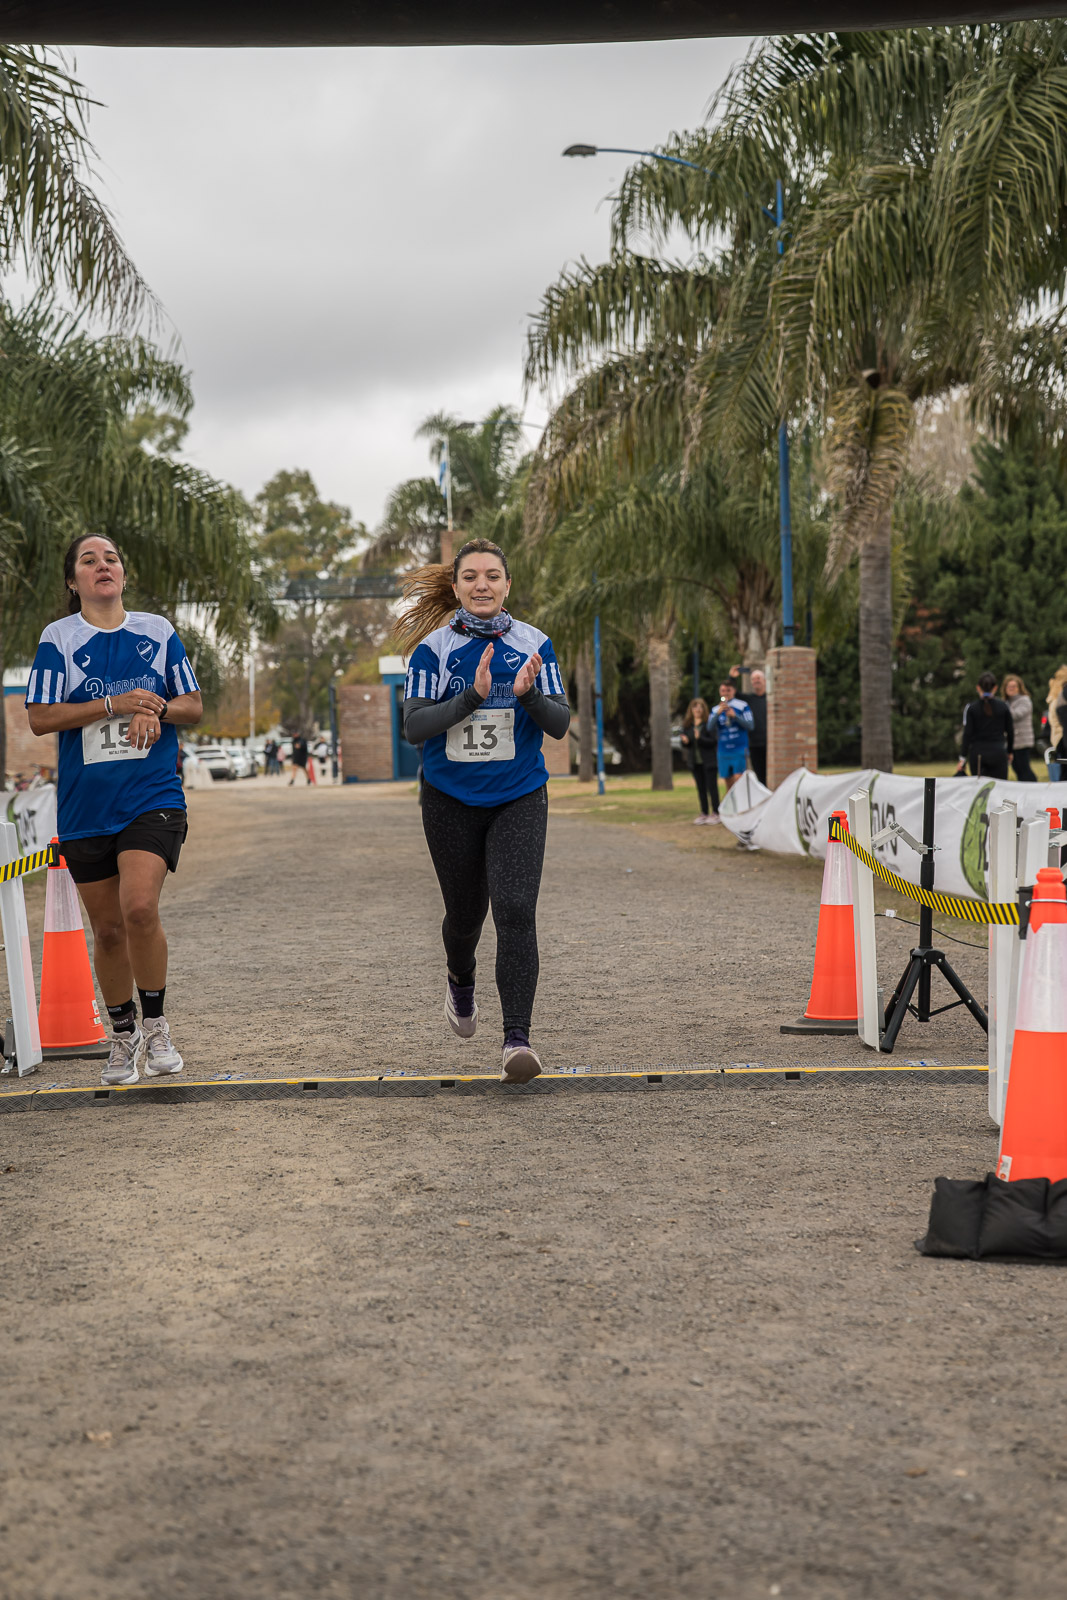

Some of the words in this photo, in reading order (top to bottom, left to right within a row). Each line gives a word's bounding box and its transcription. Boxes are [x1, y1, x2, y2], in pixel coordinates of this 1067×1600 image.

[85, 677, 104, 700] 3
[105, 674, 156, 697] MARATÓN
[463, 725, 498, 750] 13
